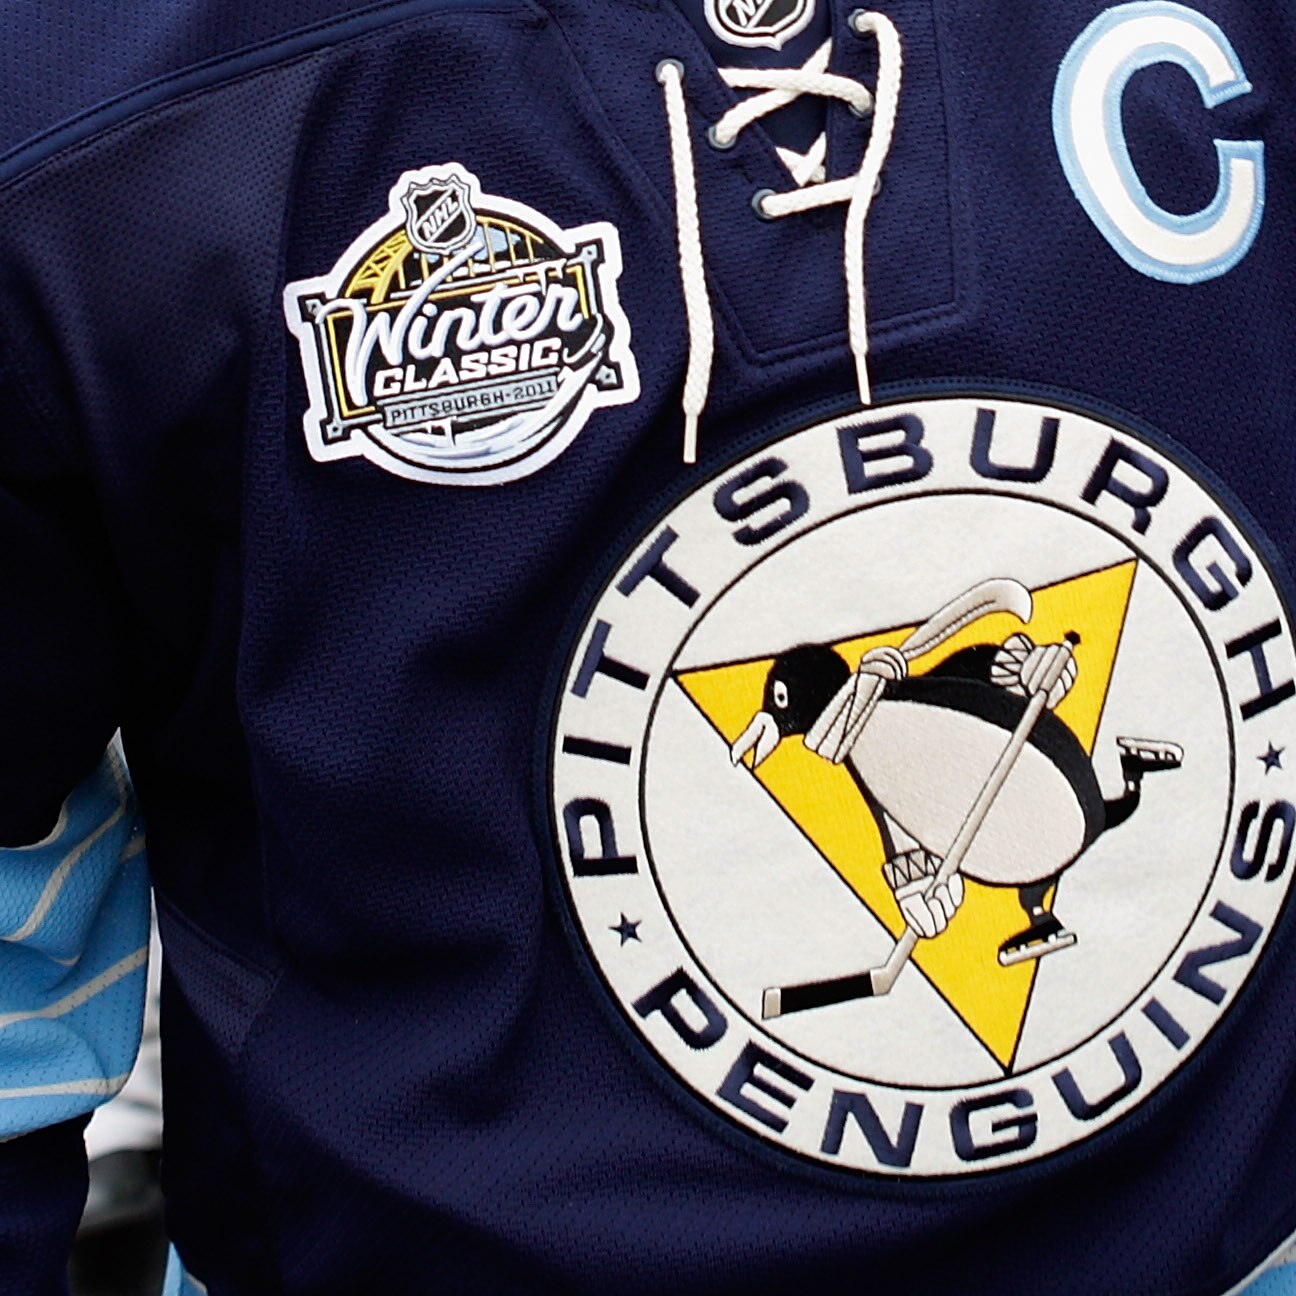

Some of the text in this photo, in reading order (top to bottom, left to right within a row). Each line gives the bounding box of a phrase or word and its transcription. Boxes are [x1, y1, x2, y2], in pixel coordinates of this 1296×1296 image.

[421, 197, 460, 240] NHL
[1052, 0, 1266, 285] C
[315, 239, 584, 407] Winter
[374, 337, 563, 397] CLASSIC
[563, 408, 1296, 880] PITTSBURGH
